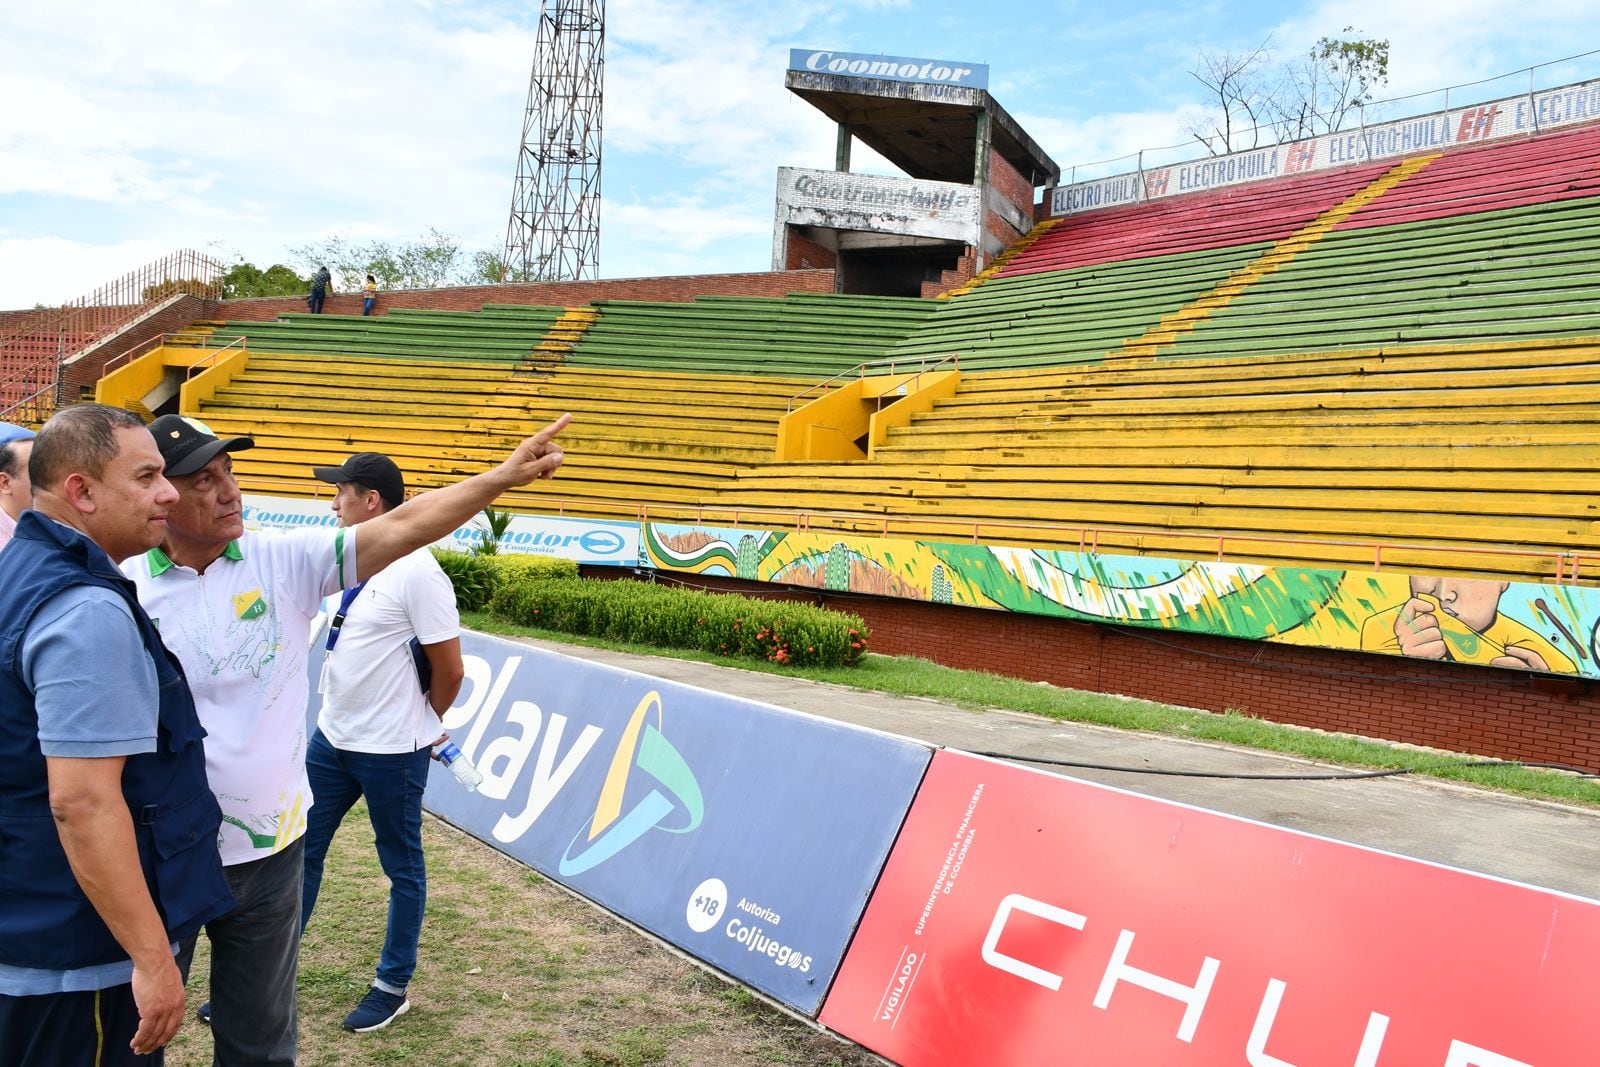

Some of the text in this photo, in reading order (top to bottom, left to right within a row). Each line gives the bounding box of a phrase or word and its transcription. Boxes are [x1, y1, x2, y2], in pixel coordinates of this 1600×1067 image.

[806, 51, 971, 82] Coomotor
[1054, 184, 1101, 213] ELECTRO
[1103, 176, 1138, 204] HUILA
[1179, 158, 1236, 190] ELECTRO
[1237, 150, 1278, 180] HUILA
[1330, 128, 1397, 163] ELECTRO
[1401, 111, 1451, 149] HUILA
[242, 504, 339, 527] Coomoto
[914, 783, 985, 936] SUPERINTENDENCIA FINANCIERA
[943, 829, 977, 895] DE COLOMBIA
[695, 895, 719, 917] +18
[736, 897, 781, 925] Autoriza
[726, 918, 812, 973] Coljuegos
[881, 953, 917, 1020] VIGILADO
